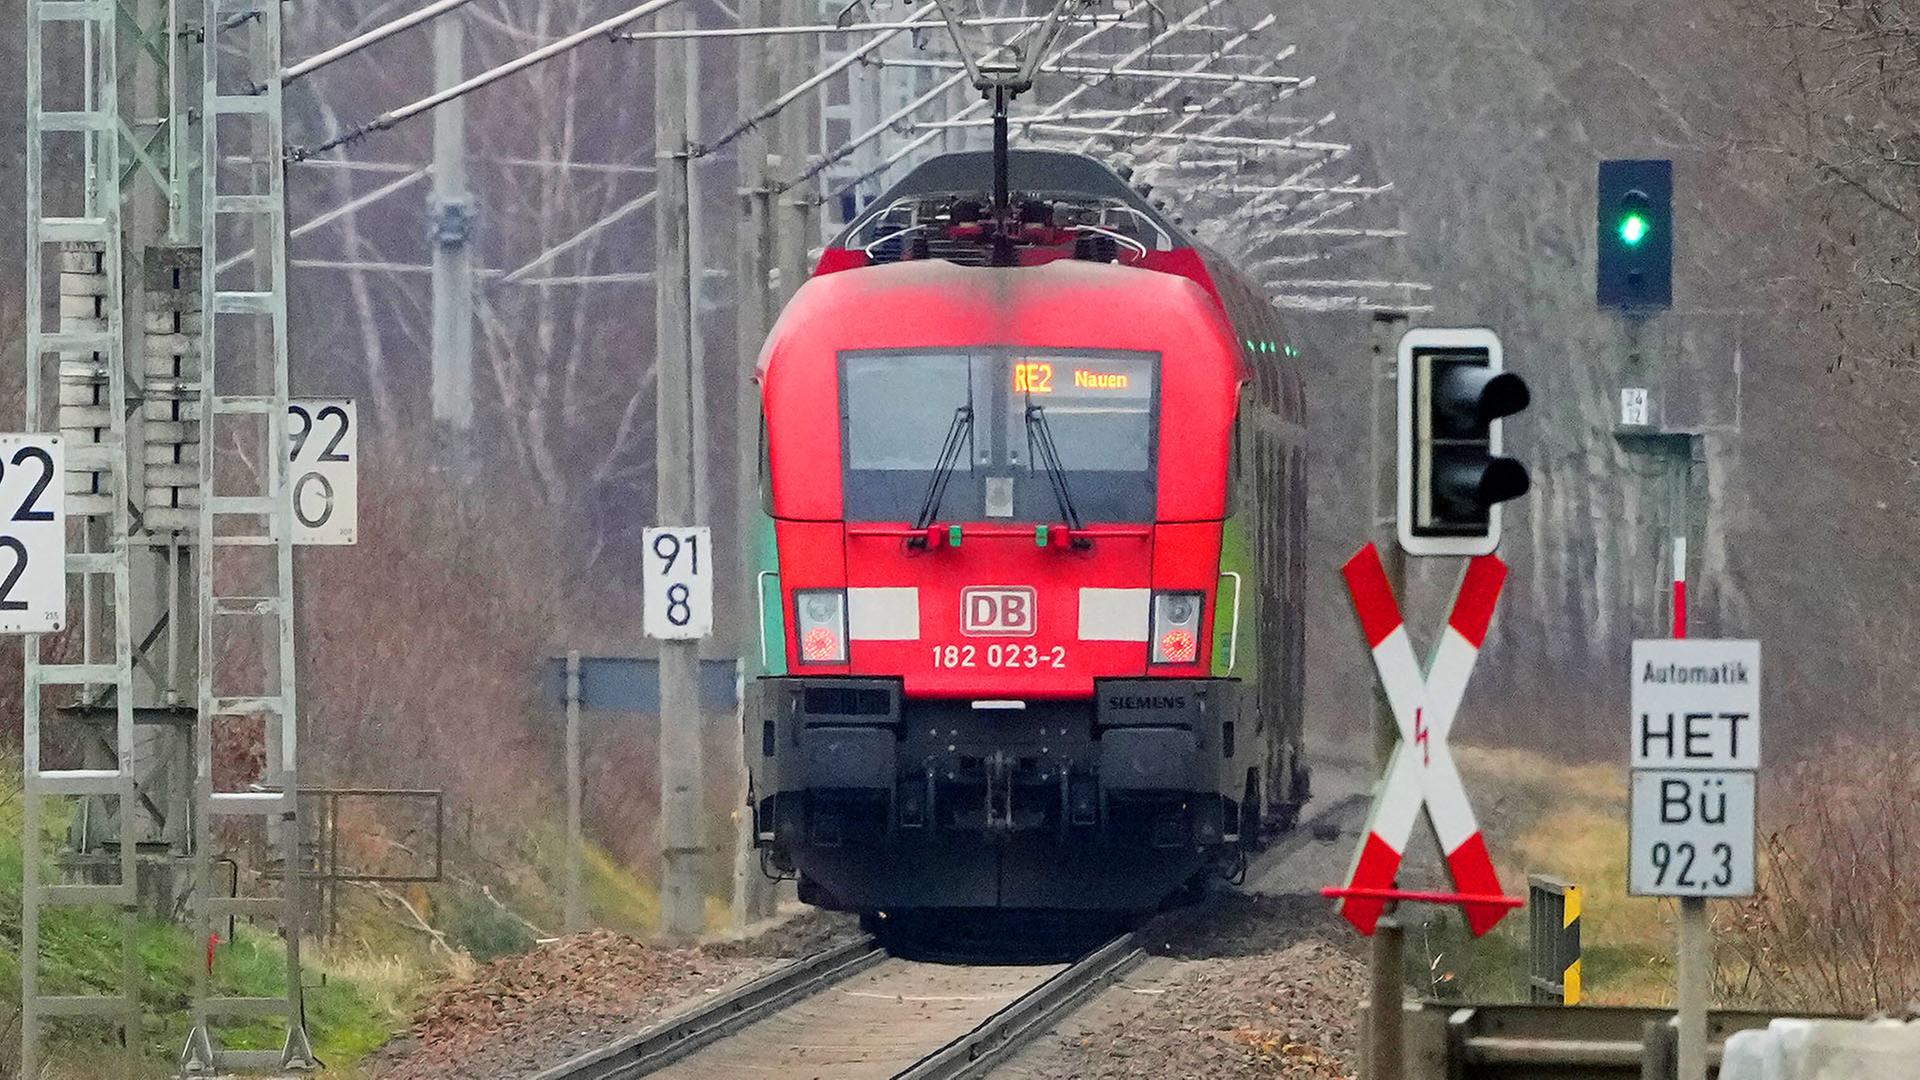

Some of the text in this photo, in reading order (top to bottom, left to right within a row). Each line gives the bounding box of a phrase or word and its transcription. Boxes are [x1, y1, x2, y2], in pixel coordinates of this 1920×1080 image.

[1013, 362, 1129, 393] RE2 Nauen
[0, 446, 55, 521] 2
[293, 471, 334, 529] 0
[0, 535, 29, 611] 2
[653, 533, 698, 575] 91
[666, 582, 691, 626] 8
[970, 595, 1027, 627] DB
[932, 644, 1066, 669] 182 023-2
[1642, 660, 1749, 684] Automatik
[1109, 696, 1186, 710] SIEMENS
[1641, 713, 1749, 759] HET
[1660, 778, 1727, 824] Bü
[1652, 842, 1733, 890] 92,3
